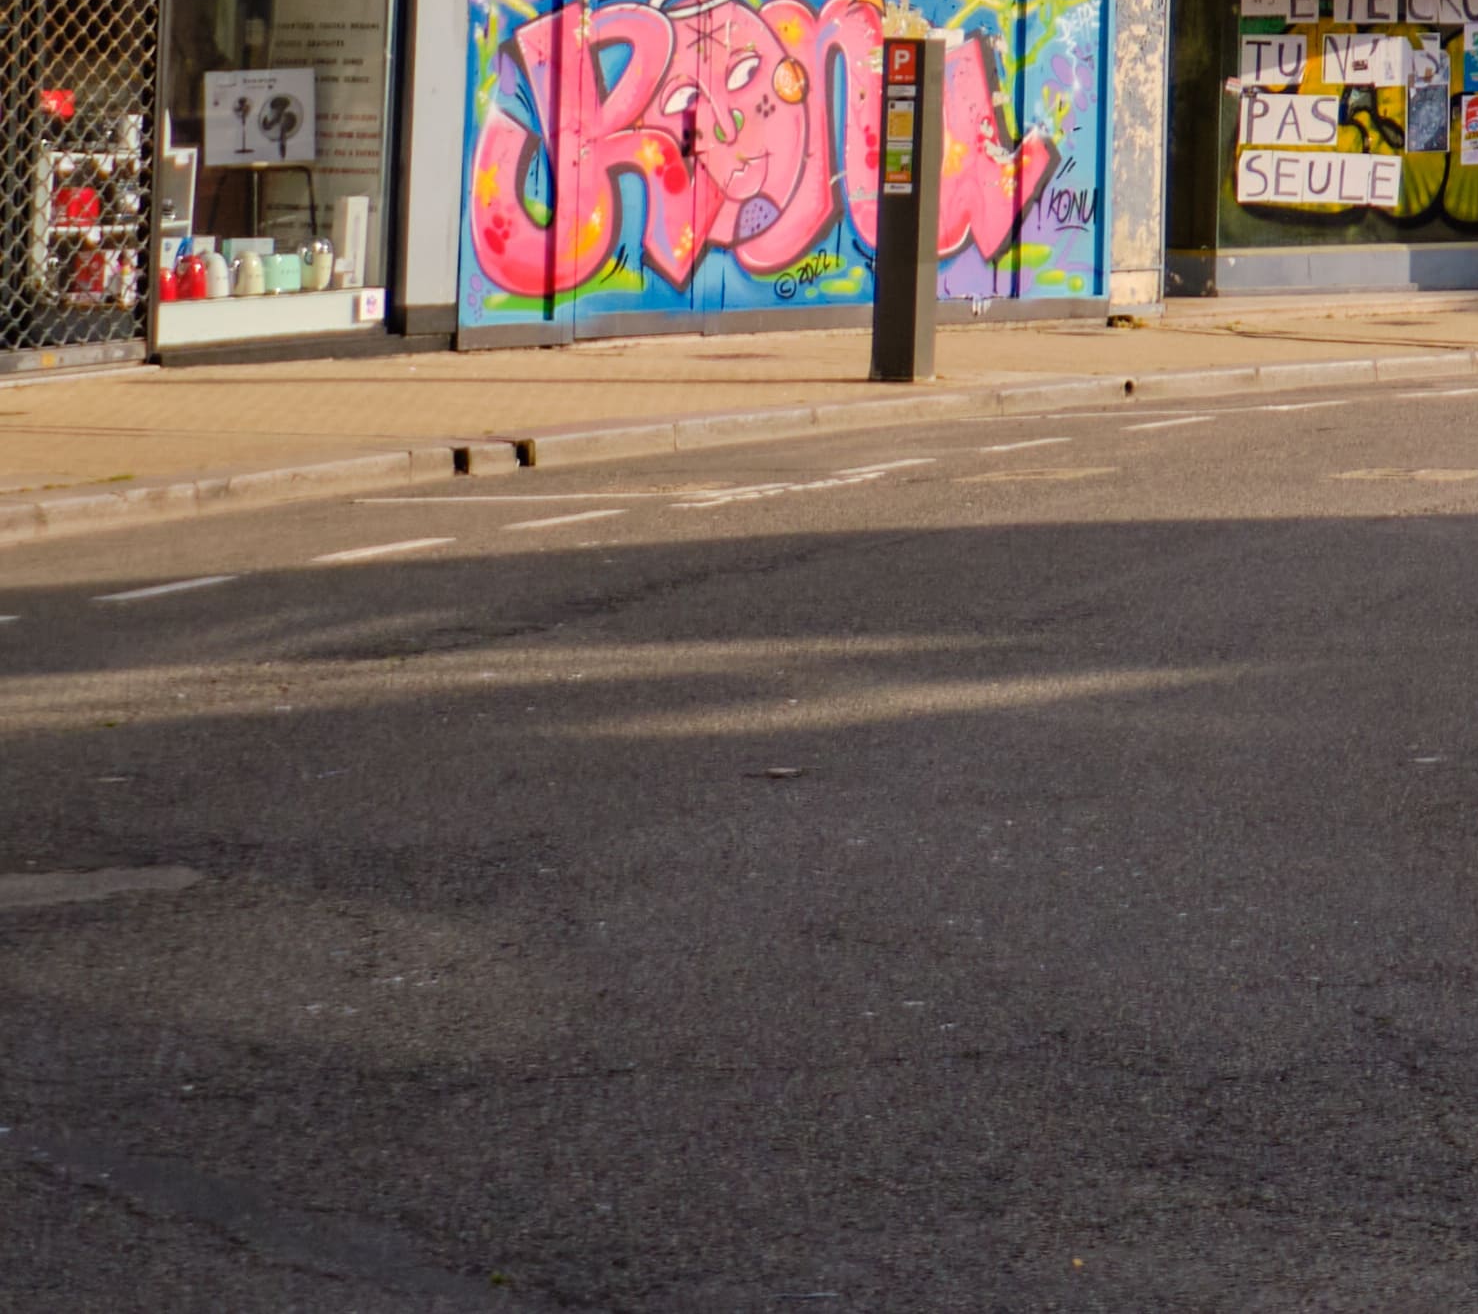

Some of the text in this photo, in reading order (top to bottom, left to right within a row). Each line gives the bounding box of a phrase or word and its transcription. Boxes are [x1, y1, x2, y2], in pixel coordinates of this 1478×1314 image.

[893, 49, 911, 71] P
[1245, 40, 1302, 82] TU
[1244, 97, 1337, 145] PAS
[1245, 154, 1396, 201] SEULE
